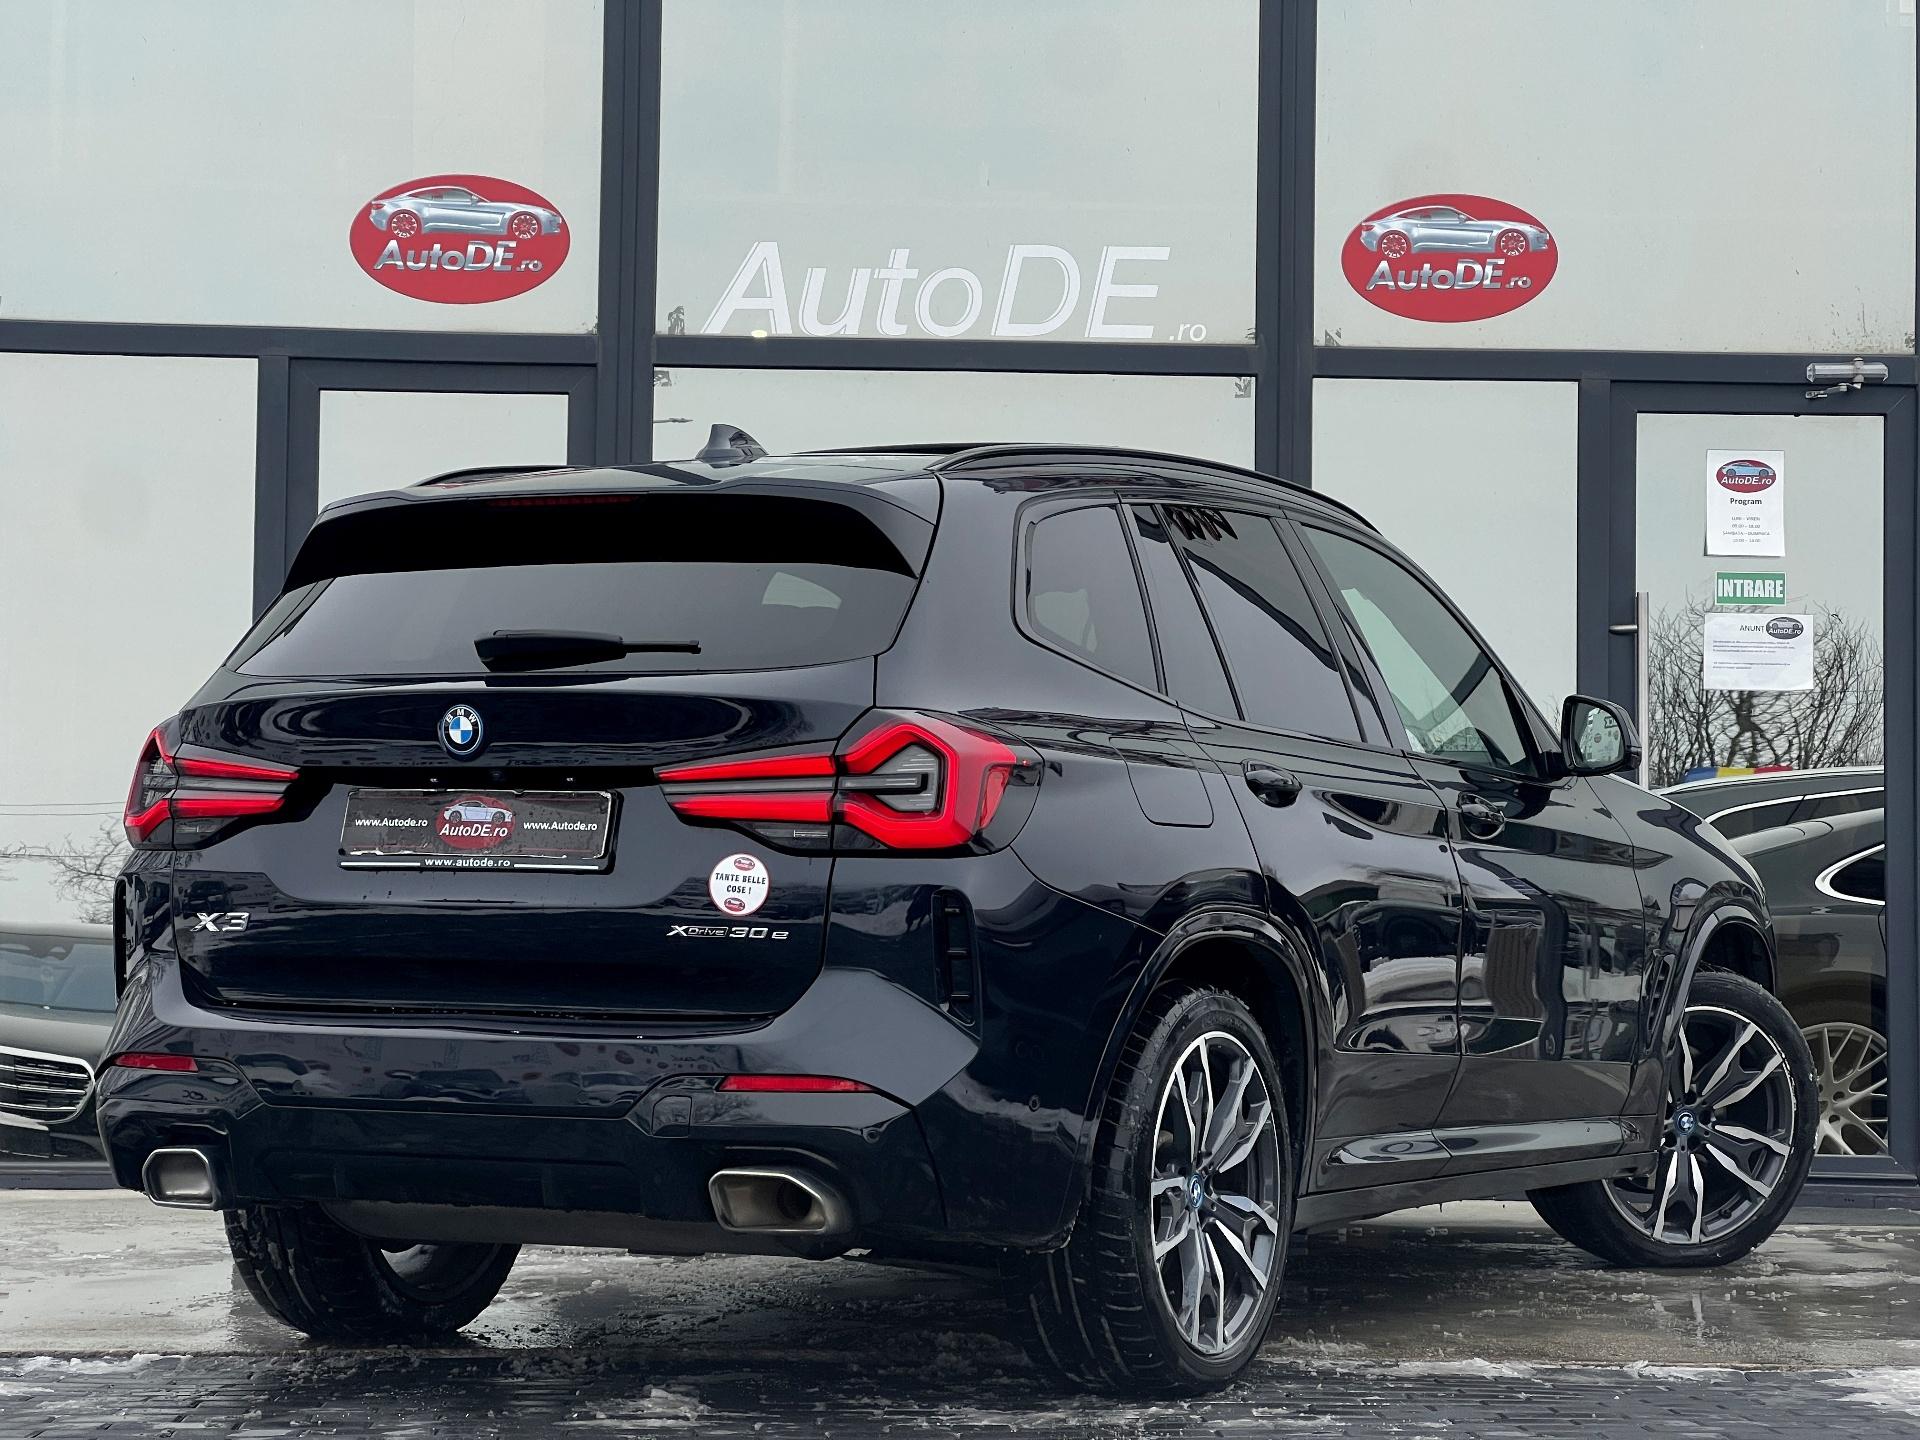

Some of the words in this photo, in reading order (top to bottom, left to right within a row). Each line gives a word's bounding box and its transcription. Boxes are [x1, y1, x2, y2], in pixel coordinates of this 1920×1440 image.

[1720, 476, 1772, 485] AutoDE.ro
[1717, 579, 1784, 598] INTRARE
[445, 708, 477, 723] BMW
[355, 817, 428, 828] www.Autode.ro
[439, 823, 508, 837] AutoDE.ro
[523, 820, 598, 832] www.Autode.ro
[424, 857, 511, 868] www.autode.ro
[715, 872, 740, 882] TANTE
[742, 875, 766, 885] BELLE
[726, 884, 746, 894] COSE
[190, 912, 250, 932] X3
